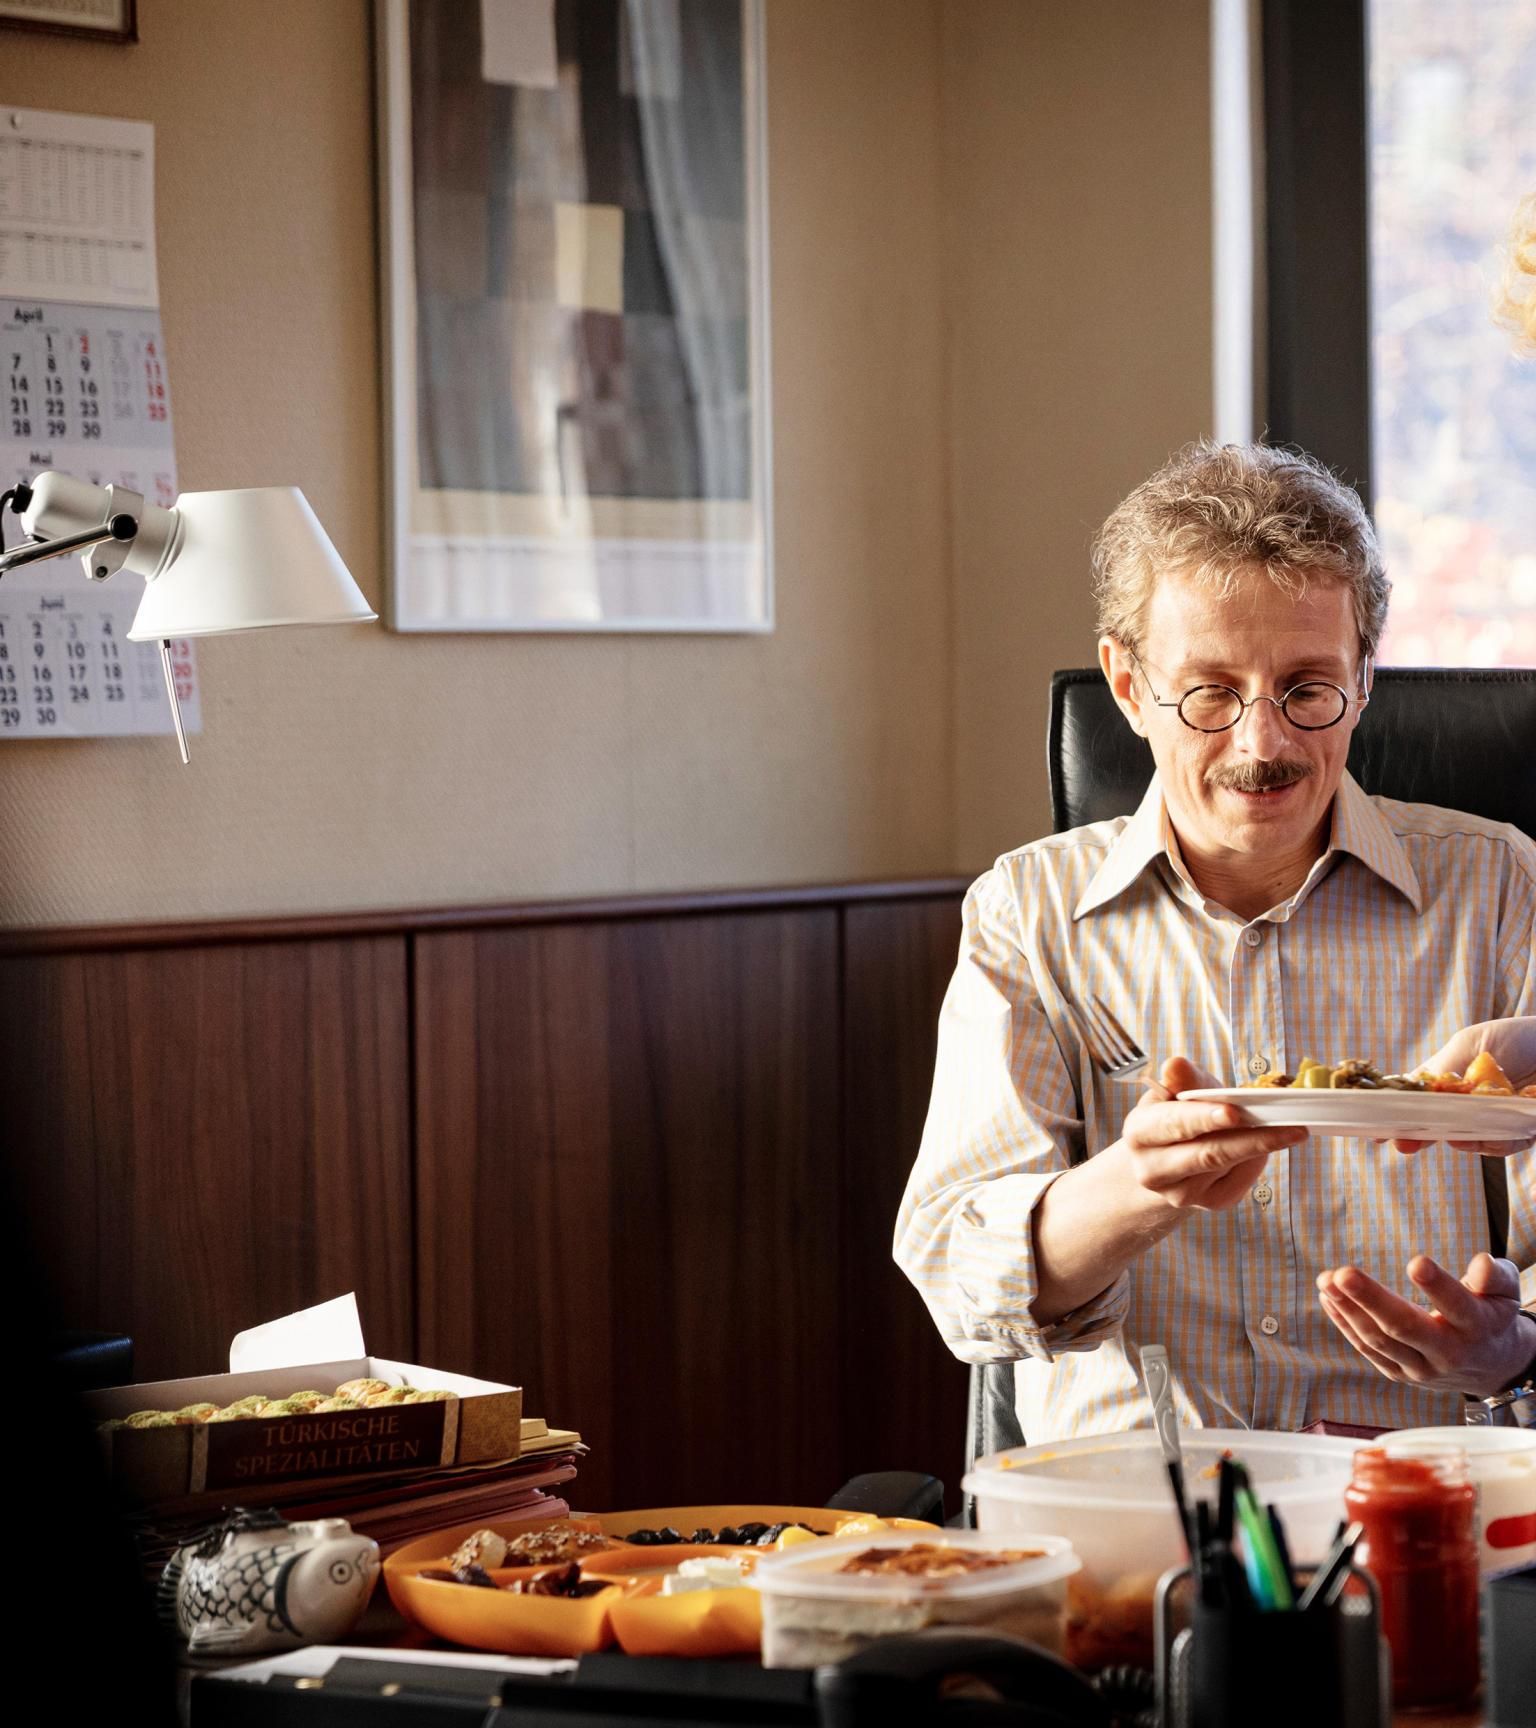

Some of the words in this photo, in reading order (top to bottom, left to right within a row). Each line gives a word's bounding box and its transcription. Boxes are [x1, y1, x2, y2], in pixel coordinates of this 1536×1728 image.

[14, 306, 43, 323] April
[12, 352, 21, 371] 7
[48, 354, 56, 372] 8
[81, 356, 90, 373] 9
[145, 359, 161, 377] 11
[11, 374, 28, 393] 14
[46, 376, 63, 395] 15
[80, 378, 98, 397] 16
[11, 397, 28, 415] 21
[45, 398, 64, 417] 22
[80, 400, 98, 418] 23
[12, 418, 31, 437] 28
[47, 420, 66, 438] 29
[82, 421, 101, 439] 30
[30, 452, 52, 466] Mai
[32, 621, 41, 638] 2
[103, 620, 112, 637] 4
[34, 643, 44, 659] 9
[67, 641, 85, 659] 10
[102, 641, 118, 659] 11
[33, 664, 52, 681] 16
[69, 663, 86, 680] 17
[104, 663, 122, 680] 18
[0, 686, 17, 703] 22
[34, 685, 54, 703] 23
[70, 684, 90, 703] 24
[105, 683, 125, 702] 25
[1, 707, 20, 727] 29
[37, 707, 56, 725] 30
[263, 1415, 399, 1447] TÜRKISCHE
[235, 1440, 420, 1477] SPEZIALITÄTEN
